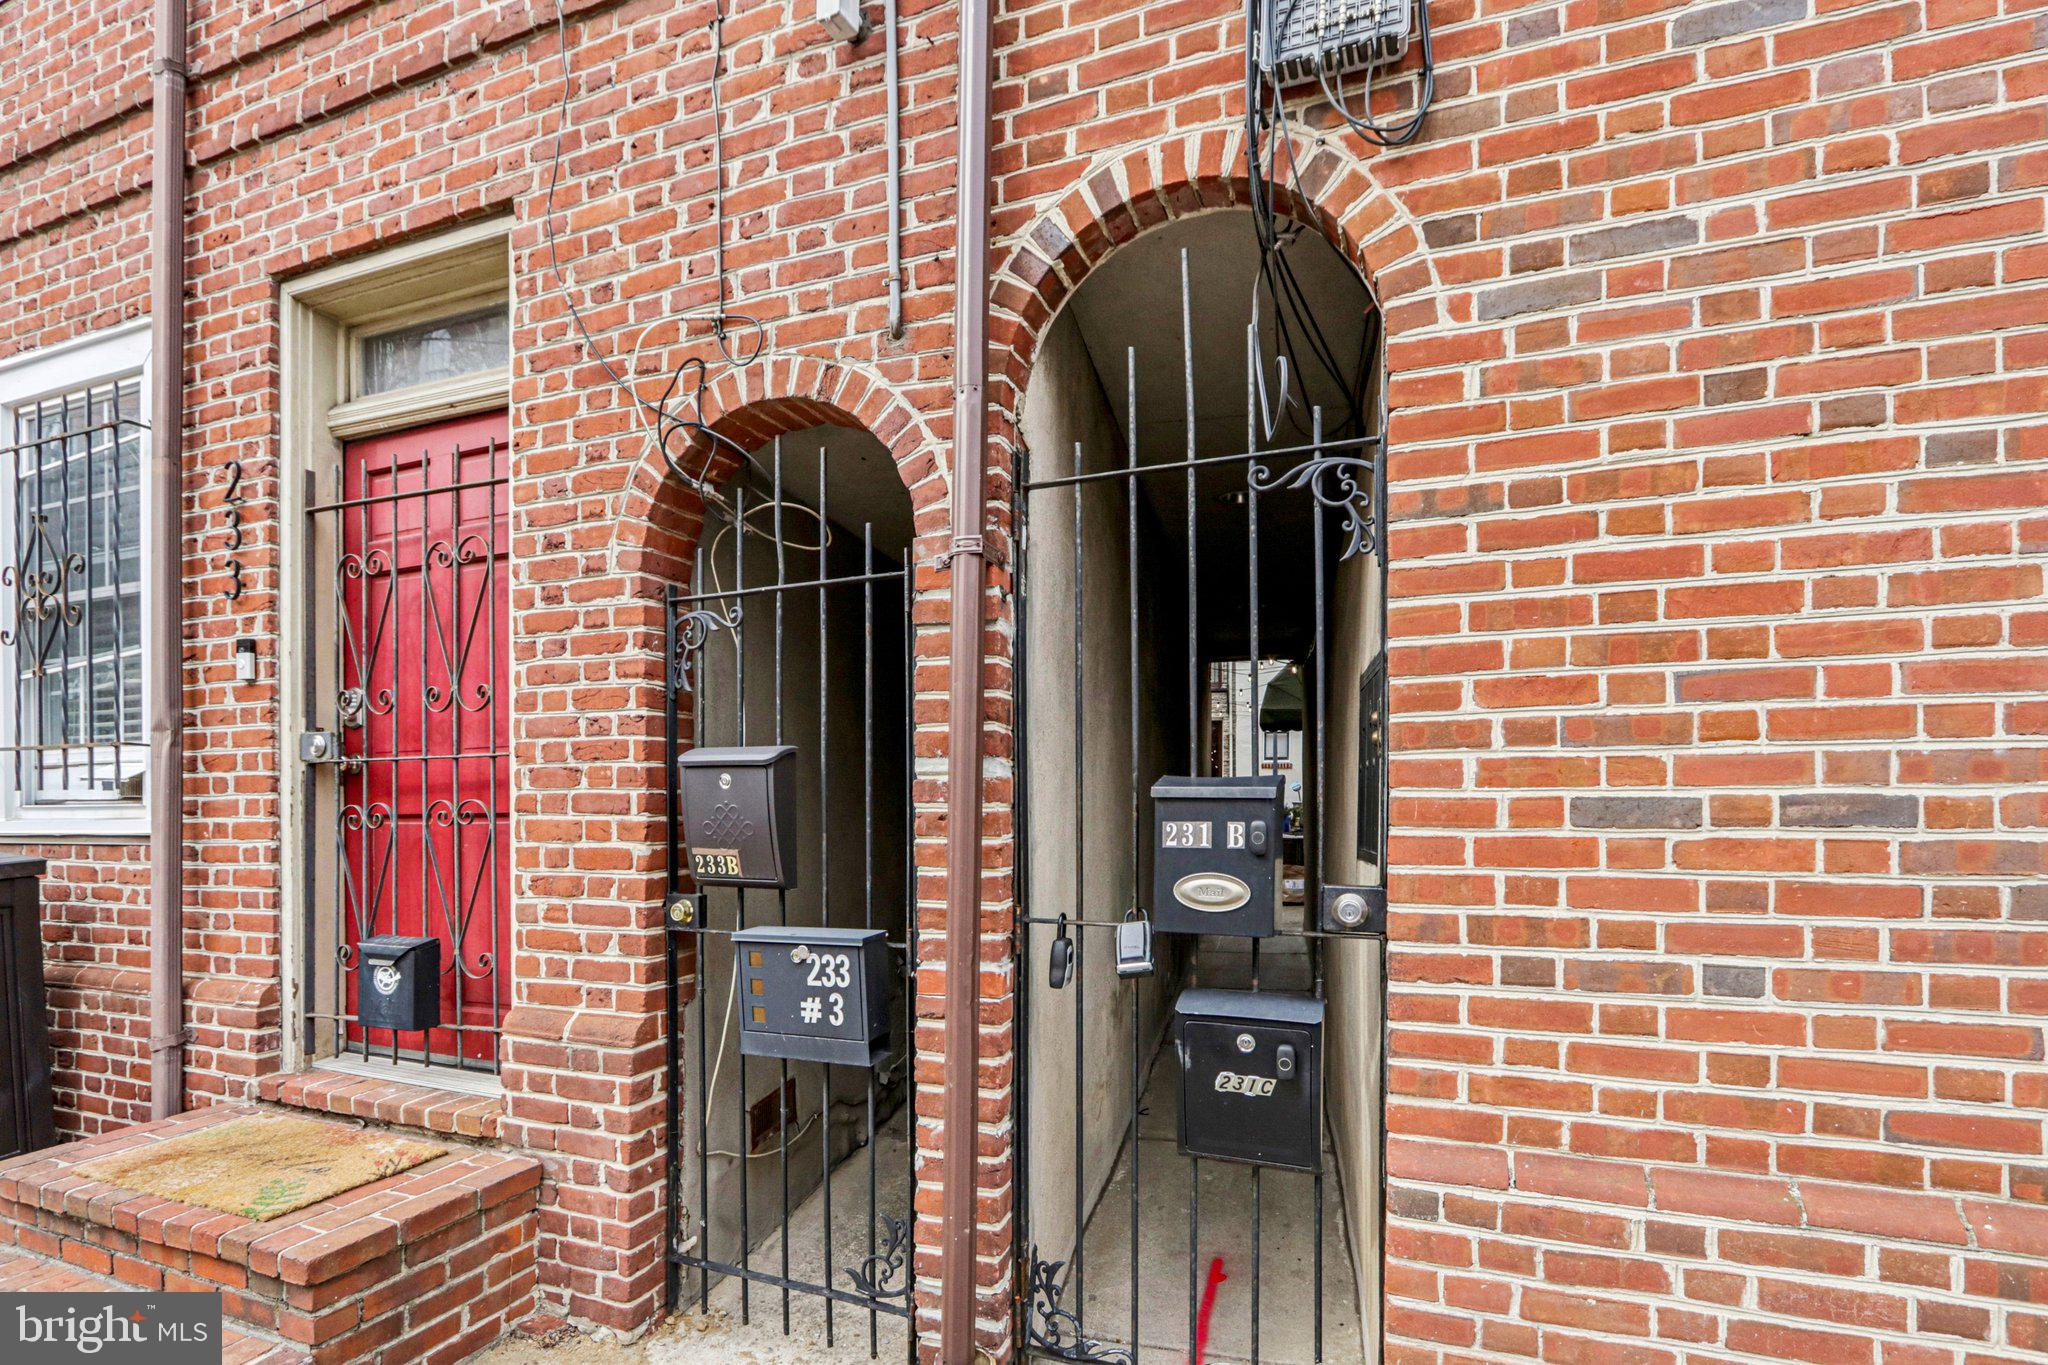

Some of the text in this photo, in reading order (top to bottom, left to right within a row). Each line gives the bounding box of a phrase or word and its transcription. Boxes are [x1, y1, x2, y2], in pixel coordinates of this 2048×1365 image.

[223, 460, 243, 601] 233
[1166, 822, 1244, 848] 231 B
[695, 855, 739, 875] 233B
[1199, 887, 1225, 898] Mail
[806, 952, 850, 988] 233
[1219, 1075, 1273, 1094] 231C
